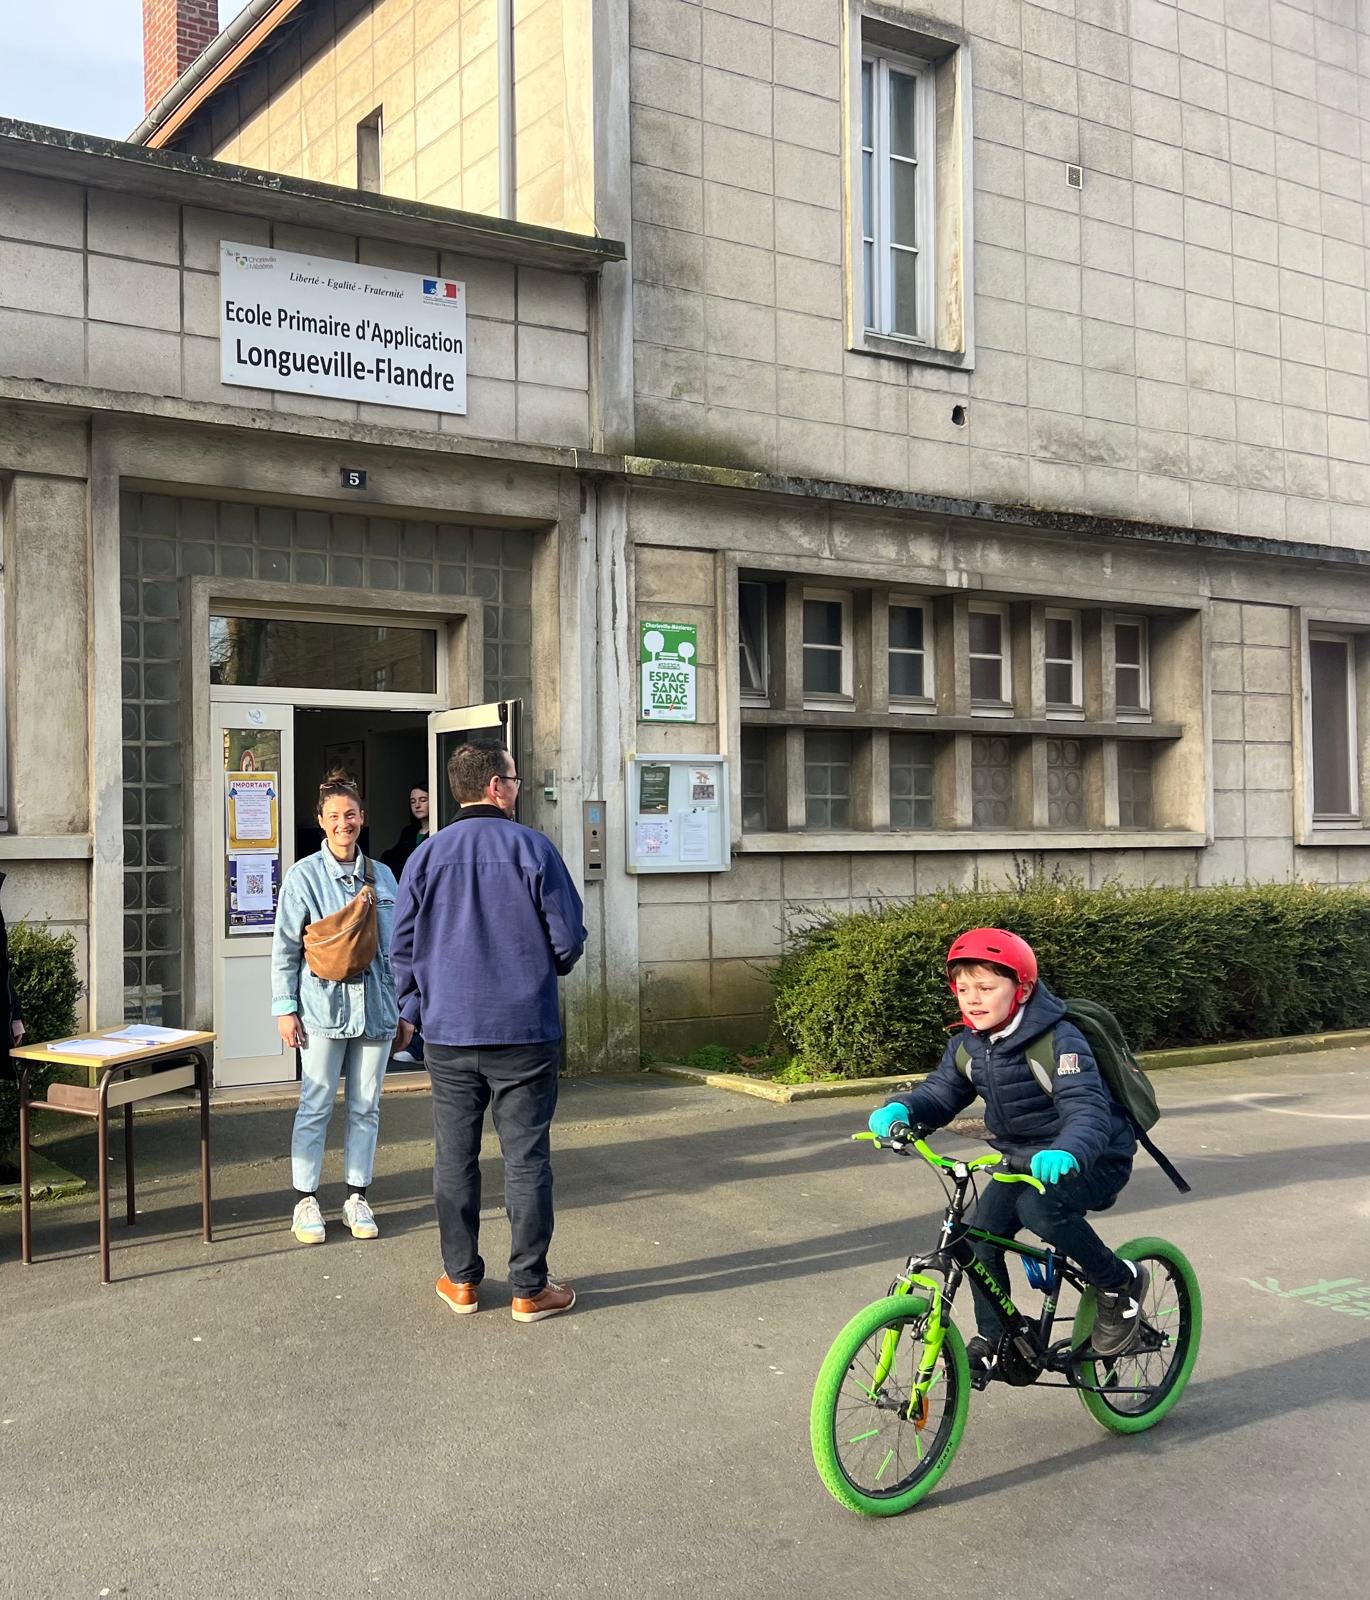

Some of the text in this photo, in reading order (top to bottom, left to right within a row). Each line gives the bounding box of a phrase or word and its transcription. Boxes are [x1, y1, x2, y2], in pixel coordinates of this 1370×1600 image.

[289, 272, 320, 285] Liberté
[327, 278, 356, 290] Egalité
[364, 284, 404, 299] Fraternité
[226, 300, 463, 355] Ecole Primaire d'Application
[236, 338, 455, 392] Longueville-Flandre
[349, 472, 360, 486] 5
[649, 671, 690, 683] ESPACE
[652, 682, 686, 694] SANS
[650, 693, 688, 705] TABAC
